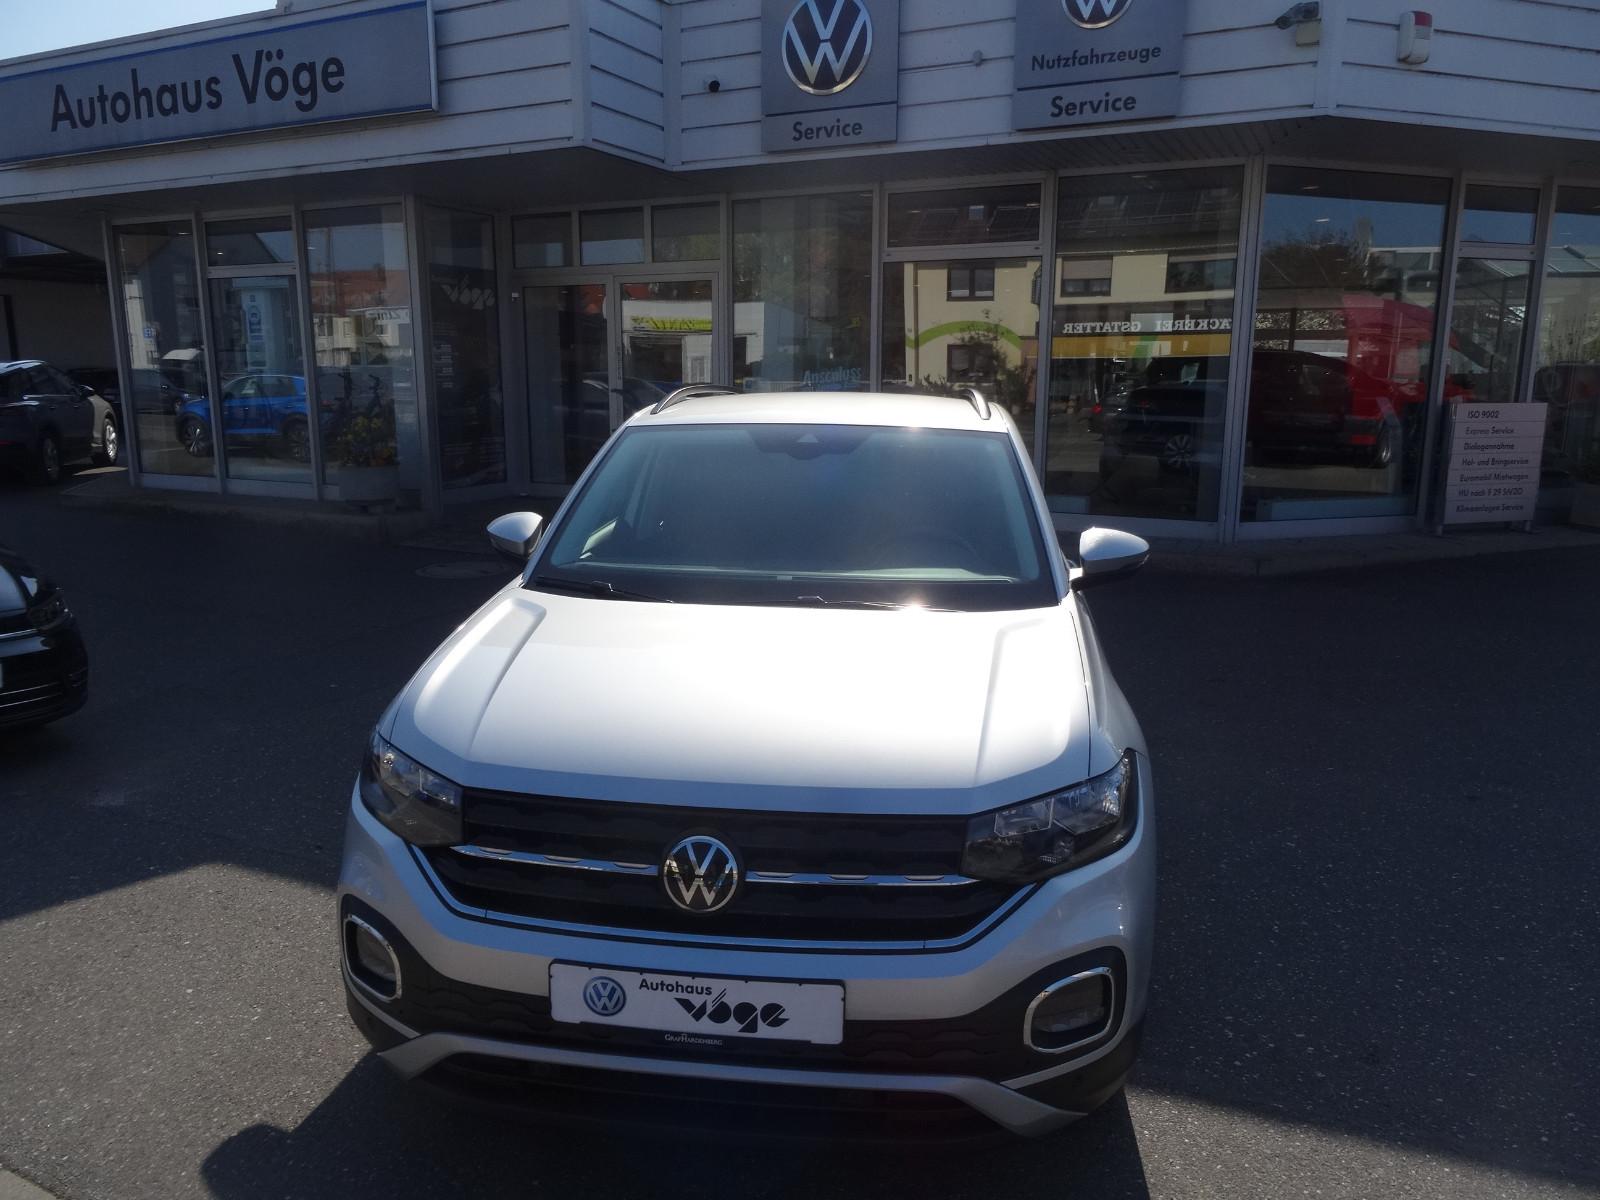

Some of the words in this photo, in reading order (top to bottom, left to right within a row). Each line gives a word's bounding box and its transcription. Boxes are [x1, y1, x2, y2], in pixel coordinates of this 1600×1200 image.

[1032, 43, 1163, 72] Nutzfahrzeuge
[51, 69, 223, 132] Autohaus
[232, 49, 346, 112] Vöge
[1050, 92, 1138, 118] Service
[792, 119, 864, 142] Service
[1467, 410, 1480, 418] ISO
[1481, 410, 1499, 418] 9002
[1491, 426, 1514, 434] Service
[639, 978, 713, 997] Autohaus
